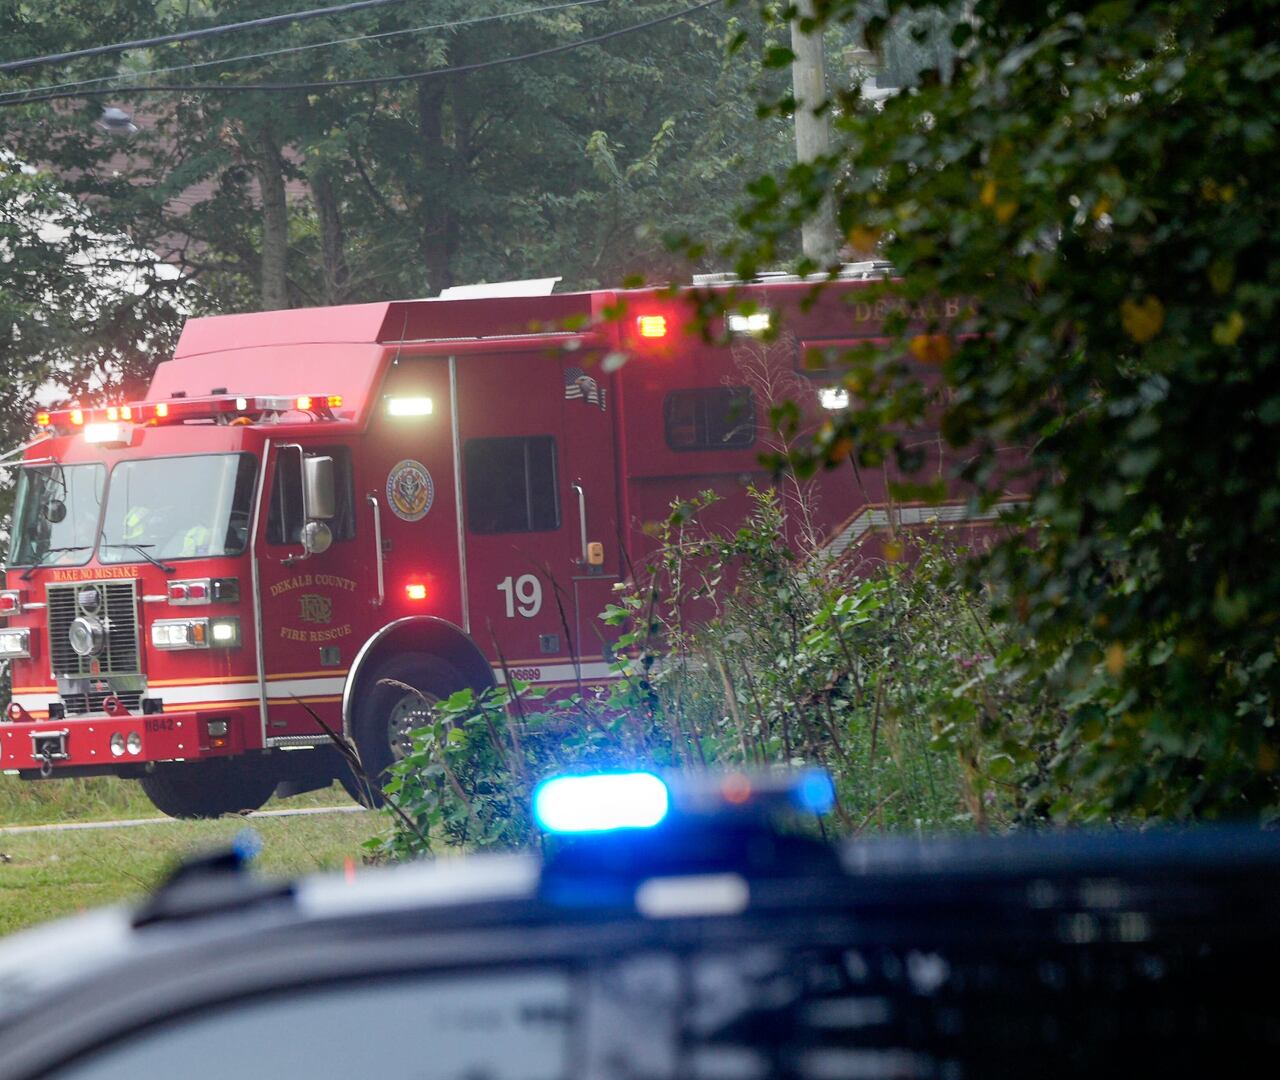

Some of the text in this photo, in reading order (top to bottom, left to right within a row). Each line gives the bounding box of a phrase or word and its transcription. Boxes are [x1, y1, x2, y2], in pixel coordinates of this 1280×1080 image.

[53, 566, 139, 581] MAKE NO MISTAKE
[269, 574, 358, 597] DEKALB COUNTY
[496, 573, 543, 618] 19
[280, 624, 352, 641] FIRE RESCUE
